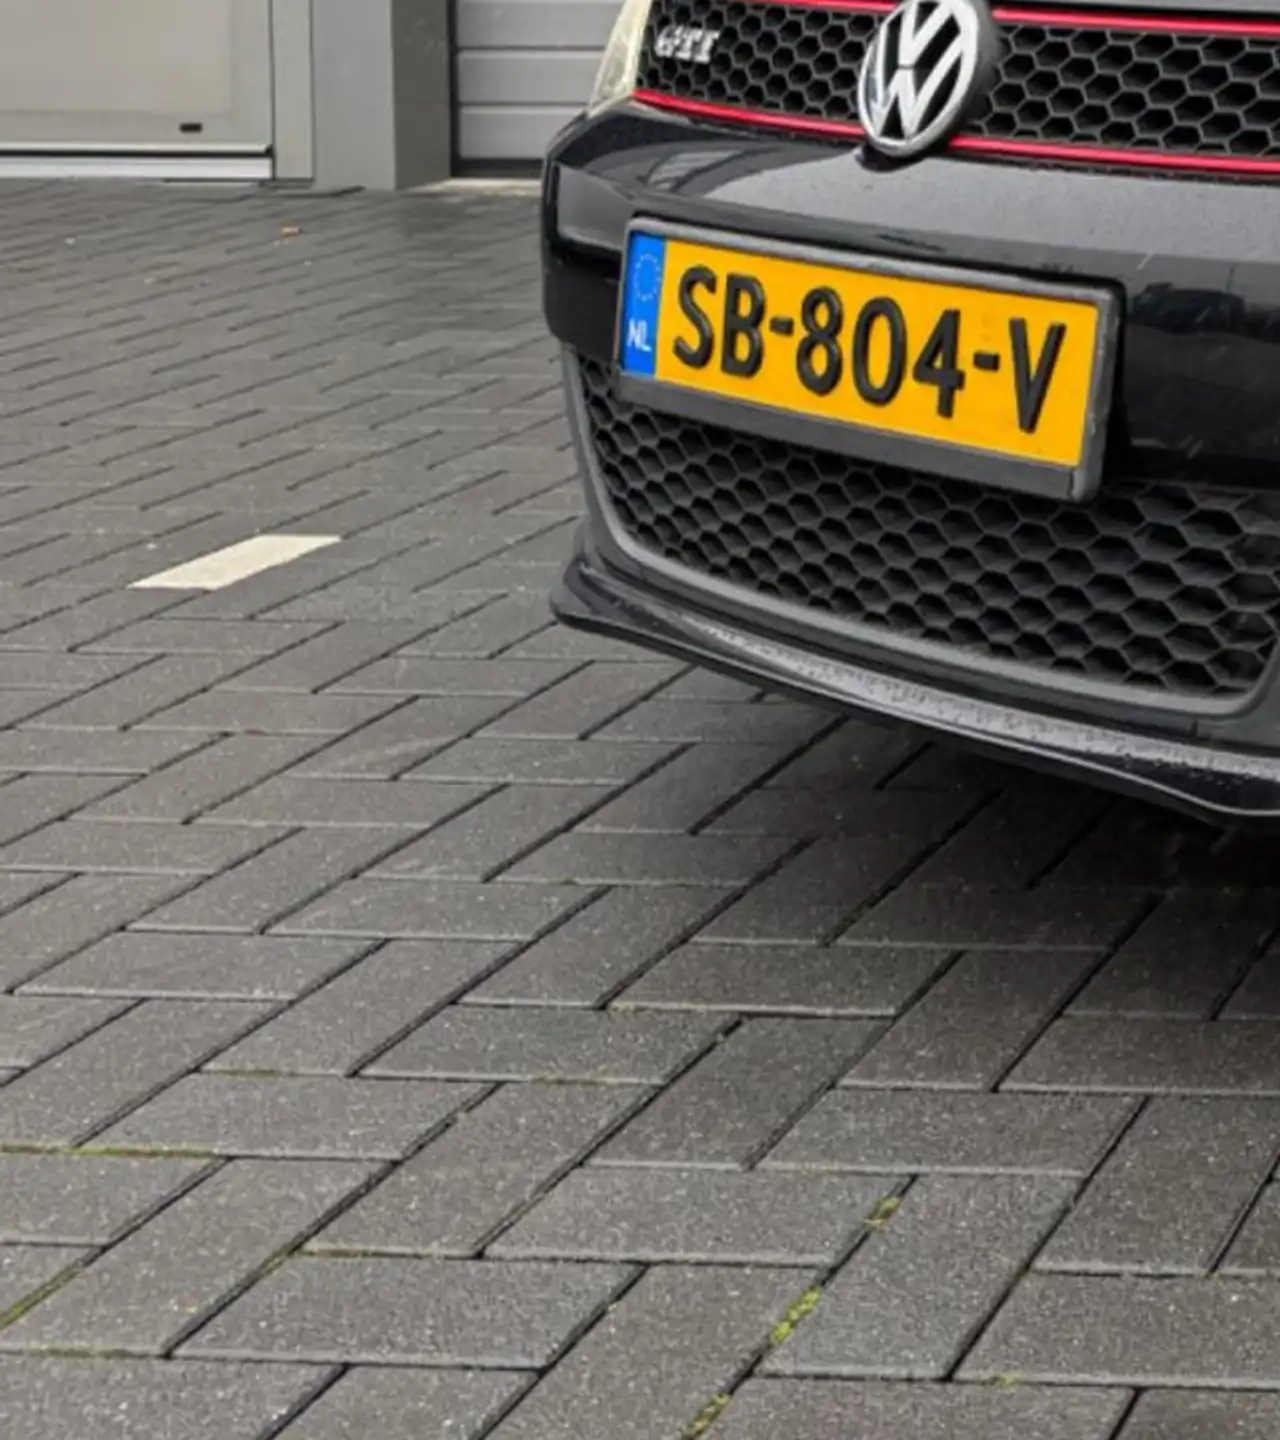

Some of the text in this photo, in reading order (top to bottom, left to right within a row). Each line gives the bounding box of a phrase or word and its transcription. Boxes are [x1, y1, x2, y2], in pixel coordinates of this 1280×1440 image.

[654, 25, 720, 64] GTI
[626, 318, 653, 354] NL
[672, 263, 1067, 435] SB-804-V
